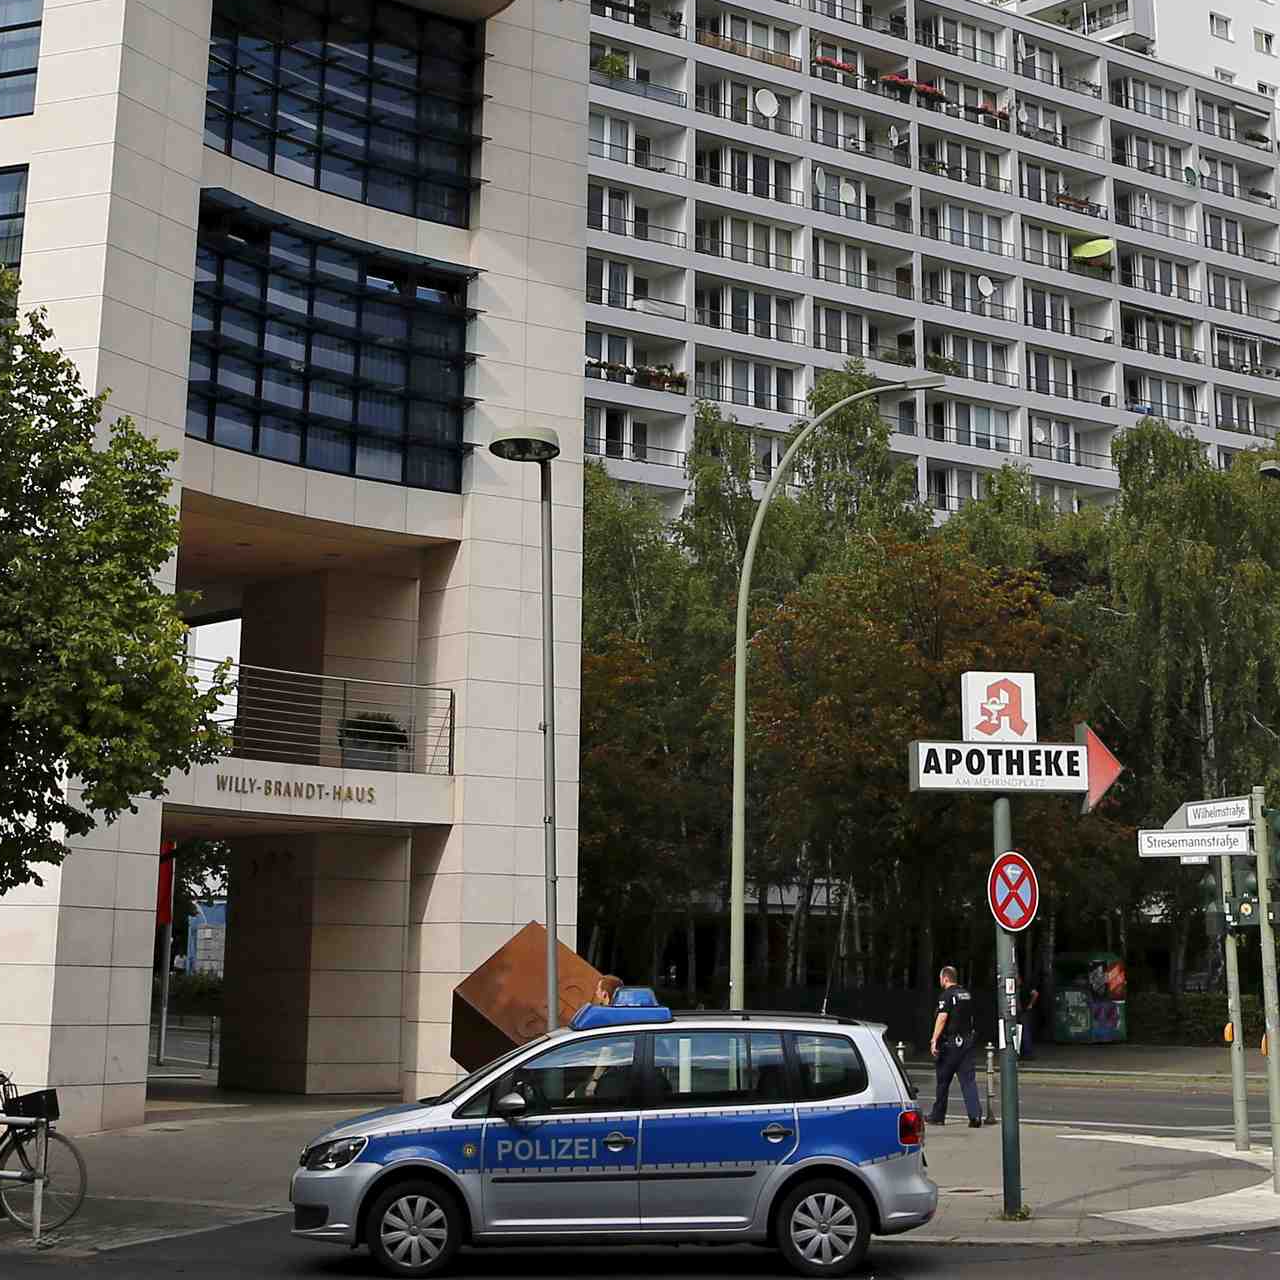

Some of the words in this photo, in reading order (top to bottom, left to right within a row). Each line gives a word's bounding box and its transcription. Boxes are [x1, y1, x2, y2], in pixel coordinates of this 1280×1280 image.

[923, 748, 1080, 777] APOTHEKE
[216, 774, 377, 803] WILLY-BRANDT-HAUS
[954, 777, 970, 785] AM
[974, 777, 1047, 787] MEHRINGPLATZ
[1192, 803, 1247, 820] Wilhelmstraße
[1146, 834, 1239, 849] Stresemannstraße
[497, 1138, 597, 1161] POLIZEI
